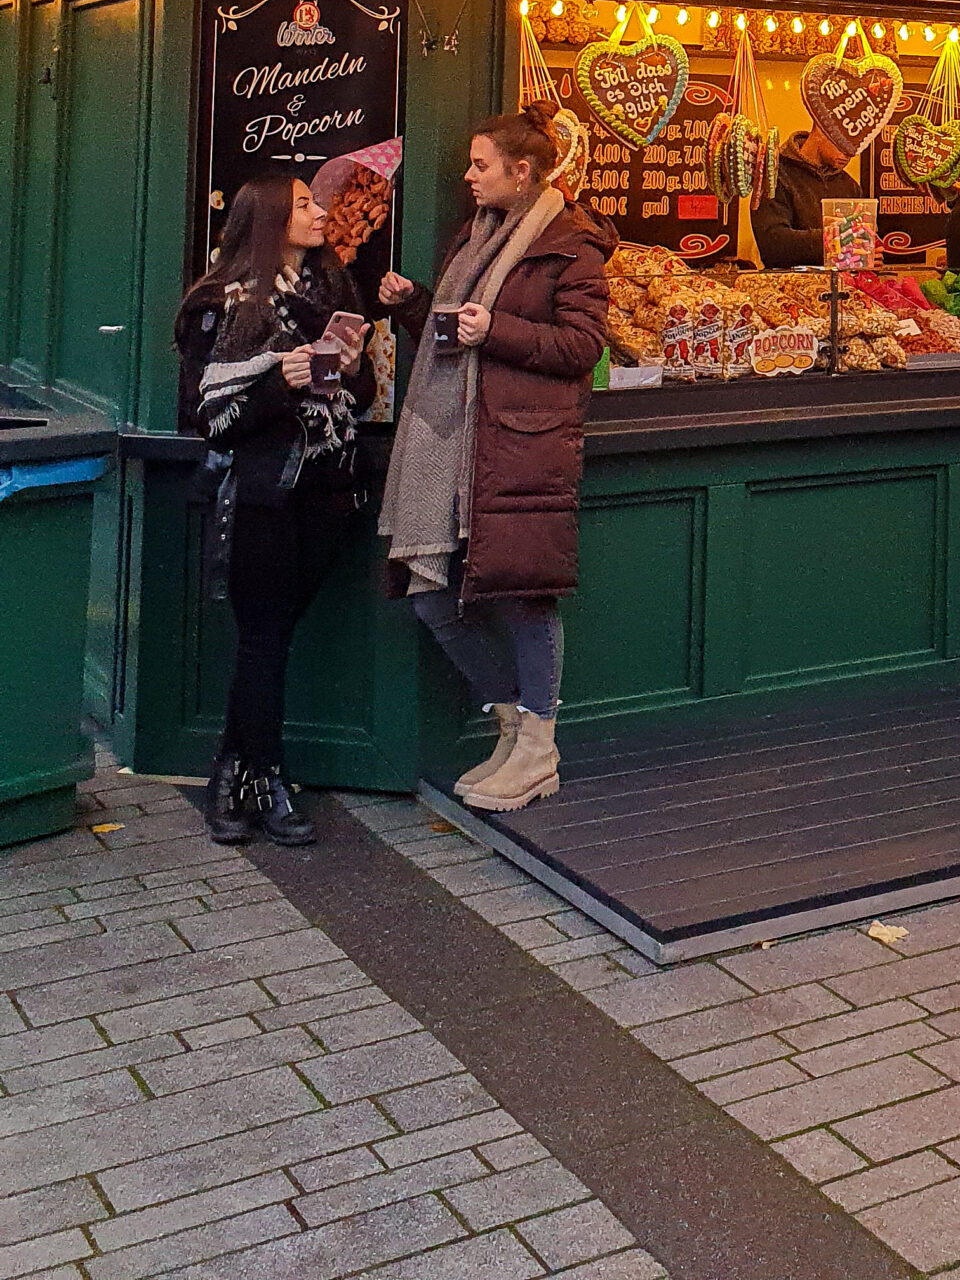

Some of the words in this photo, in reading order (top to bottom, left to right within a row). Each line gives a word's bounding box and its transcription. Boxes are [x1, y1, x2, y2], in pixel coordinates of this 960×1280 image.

[277, 21, 336, 47] Winter
[233, 52, 367, 99] Mandeln
[636, 61, 672, 80] dass
[606, 88, 625, 102] es
[627, 77, 669, 97] Dich
[821, 79, 848, 99] Für
[287, 94, 306, 116] &
[833, 86, 868, 120] mein
[243, 108, 365, 153] Popcorn
[594, 143, 620, 165] 4,00
[643, 145, 666, 163] 200
[667, 150, 682, 166] gr.
[591, 170, 619, 192] 5,00
[620, 170, 630, 189] €
[642, 170, 665, 189] 200
[666, 175, 682, 192] gr.
[618, 197, 627, 215] €
[642, 195, 670, 218] groß
[879, 195, 924, 215] FRISCHES
[754, 333, 815, 357] POPCORN
